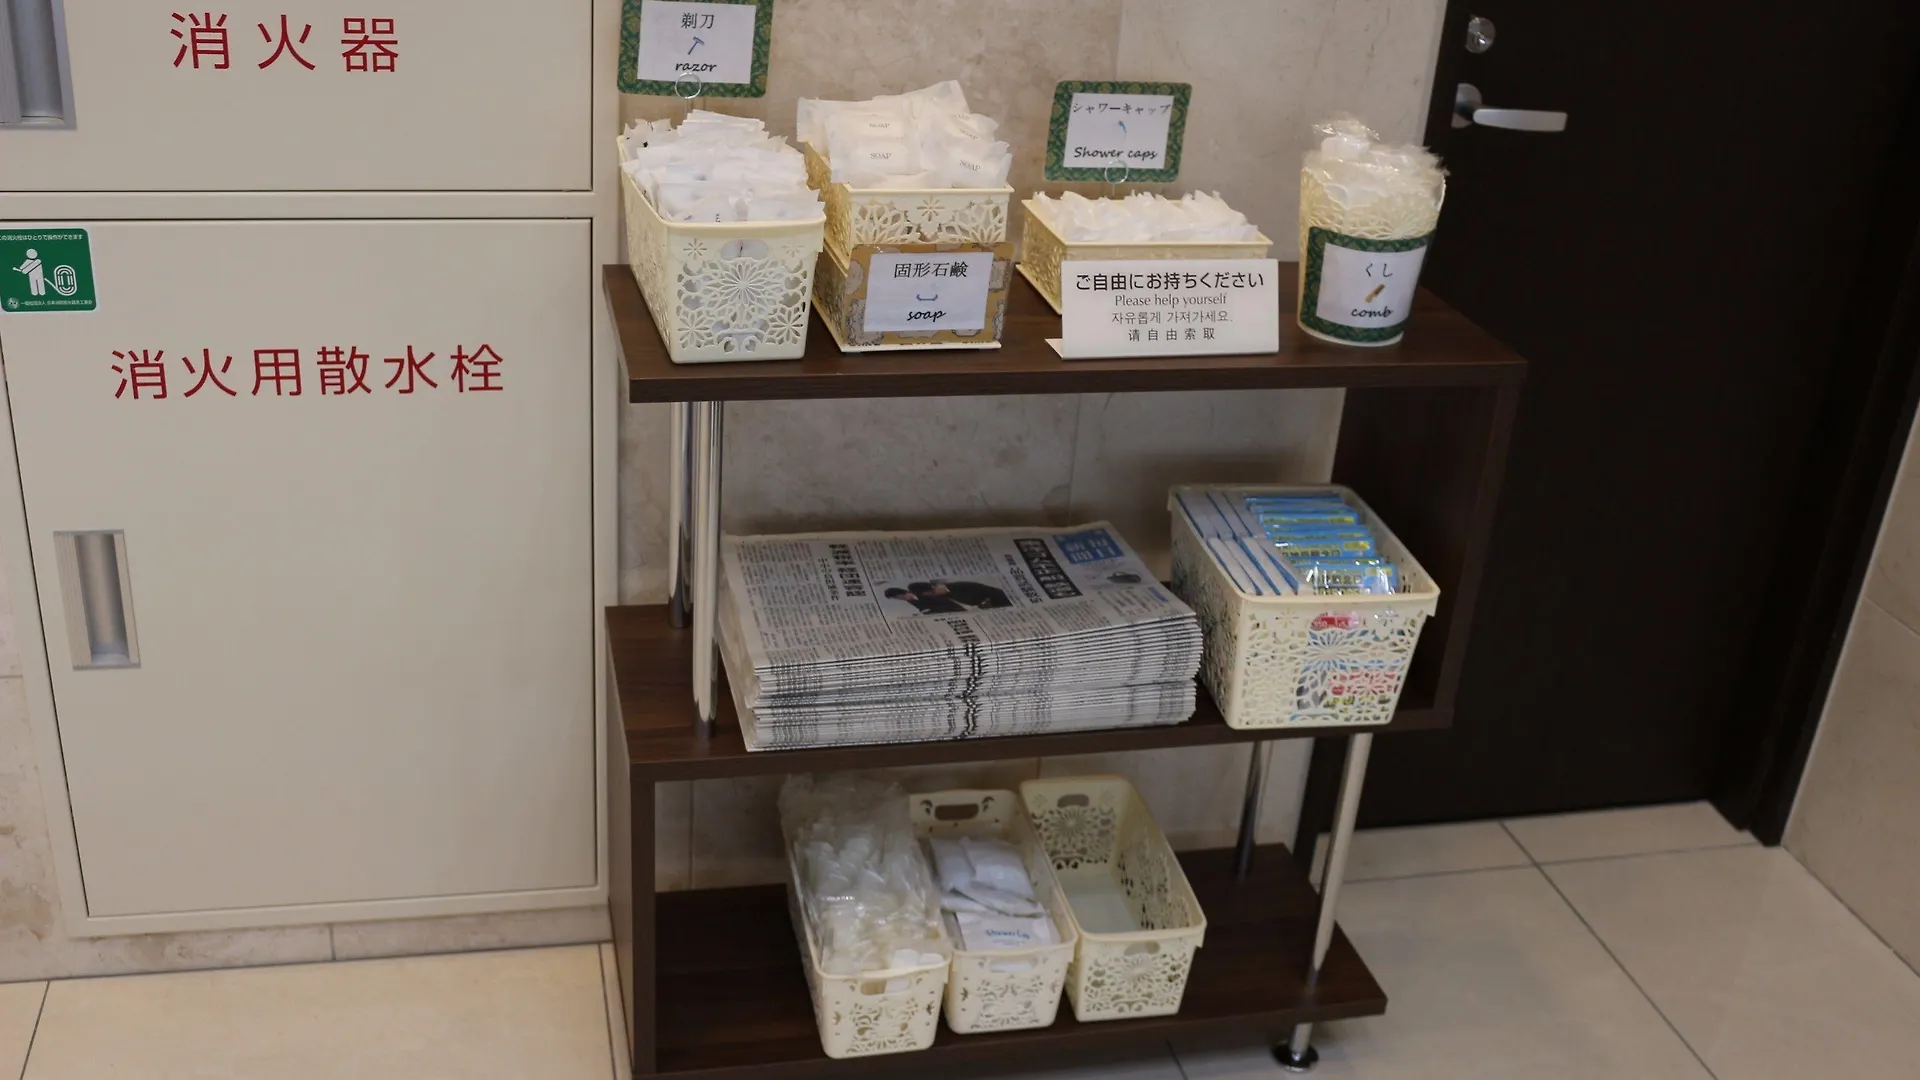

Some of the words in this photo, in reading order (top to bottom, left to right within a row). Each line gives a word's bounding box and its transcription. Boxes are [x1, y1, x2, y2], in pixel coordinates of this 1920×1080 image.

[680, 12, 715, 30] 剃刀
[170, 12, 399, 73] 消火器
[674, 62, 717, 73] razor
[1072, 102, 1172, 116] シャワーキャップ
[870, 152, 892, 160] SOAP
[1073, 146, 1124, 159] Shower
[1127, 149, 1159, 161] caps
[959, 159, 981, 172] SOAP
[893, 261, 969, 279] 固形石鹸
[1365, 263, 1393, 278] くし
[1076, 271, 1265, 292] ご自由にお持ちください
[1114, 294, 1151, 307] Please
[1154, 293, 1180, 309] help
[1182, 292, 1228, 309] yourself
[906, 310, 947, 323] soap
[1111, 311, 1162, 325] 자유롭게
[1166, 310, 1234, 324] 가져가세요.
[1350, 305, 1394, 318] comb
[1127, 327, 1216, 342] 请自由索取
[110, 343, 504, 400] 消火用散水栓
